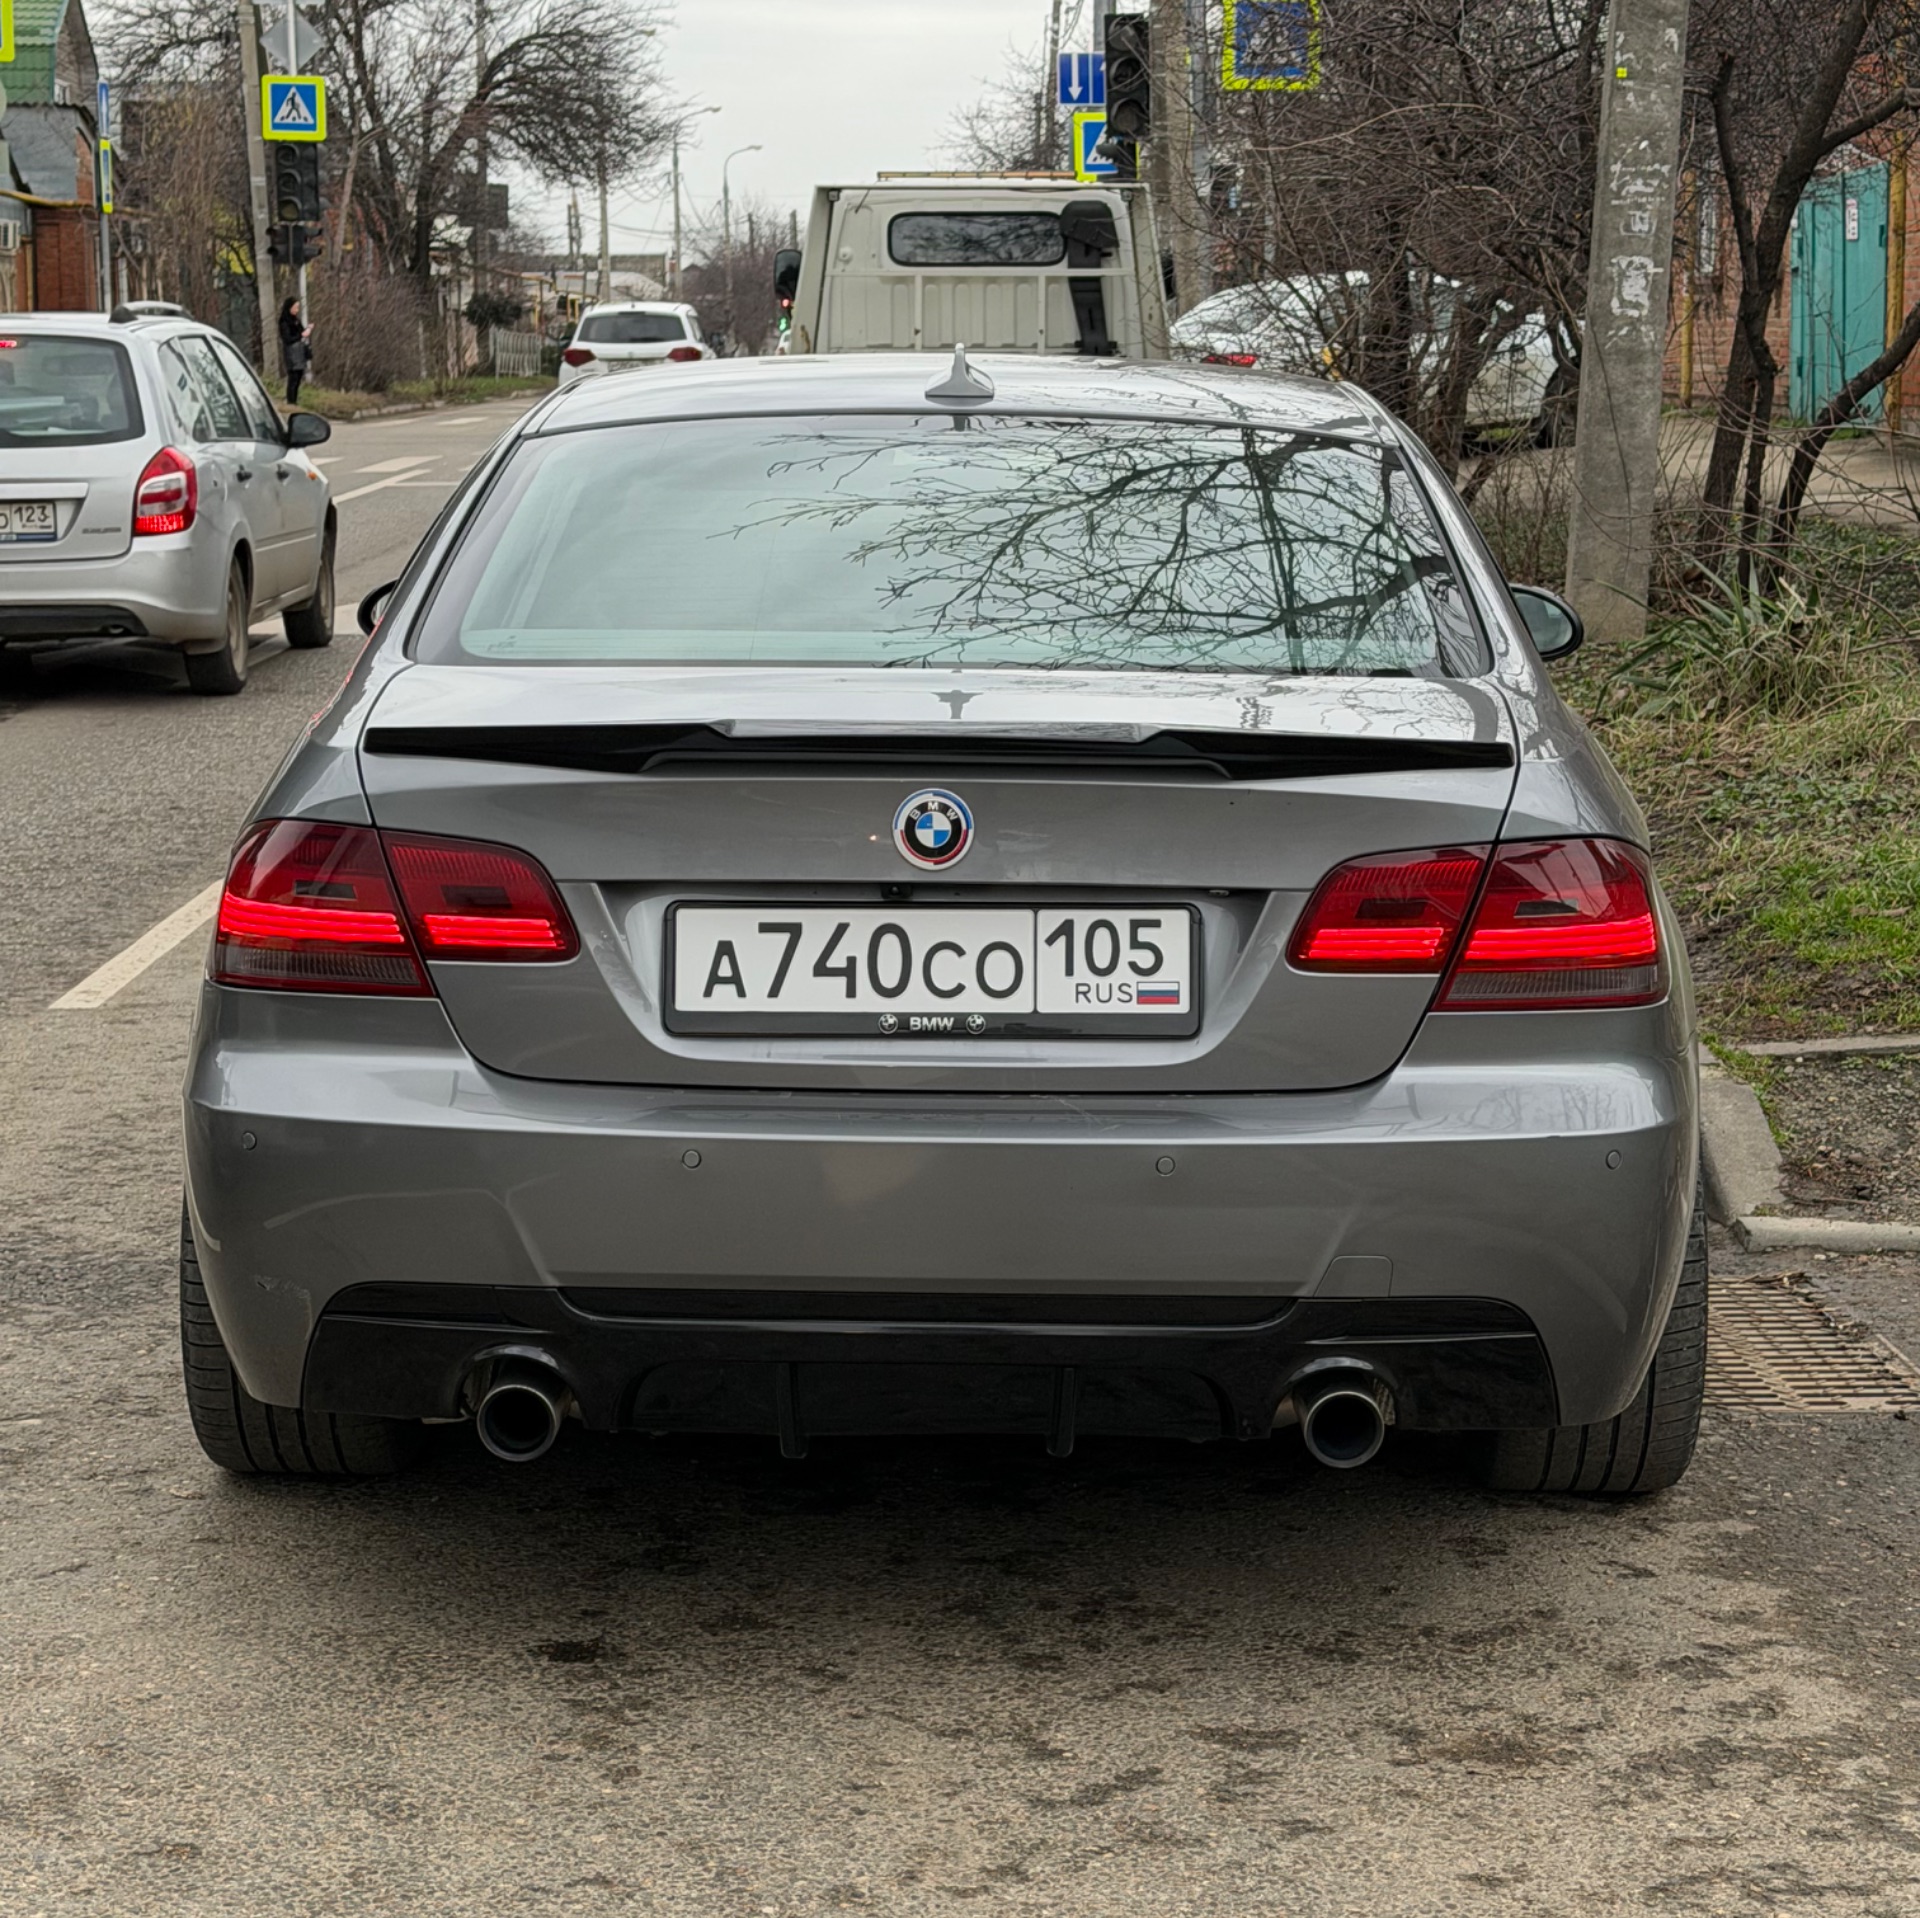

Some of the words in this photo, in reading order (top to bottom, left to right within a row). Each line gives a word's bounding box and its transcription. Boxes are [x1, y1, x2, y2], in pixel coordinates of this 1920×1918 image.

[14, 505, 50, 523] 123
[909, 801, 958, 821] BMW
[1044, 918, 1164, 977] 105
[1075, 982, 1134, 1004] RUS
[909, 1016, 955, 1031] BMW
